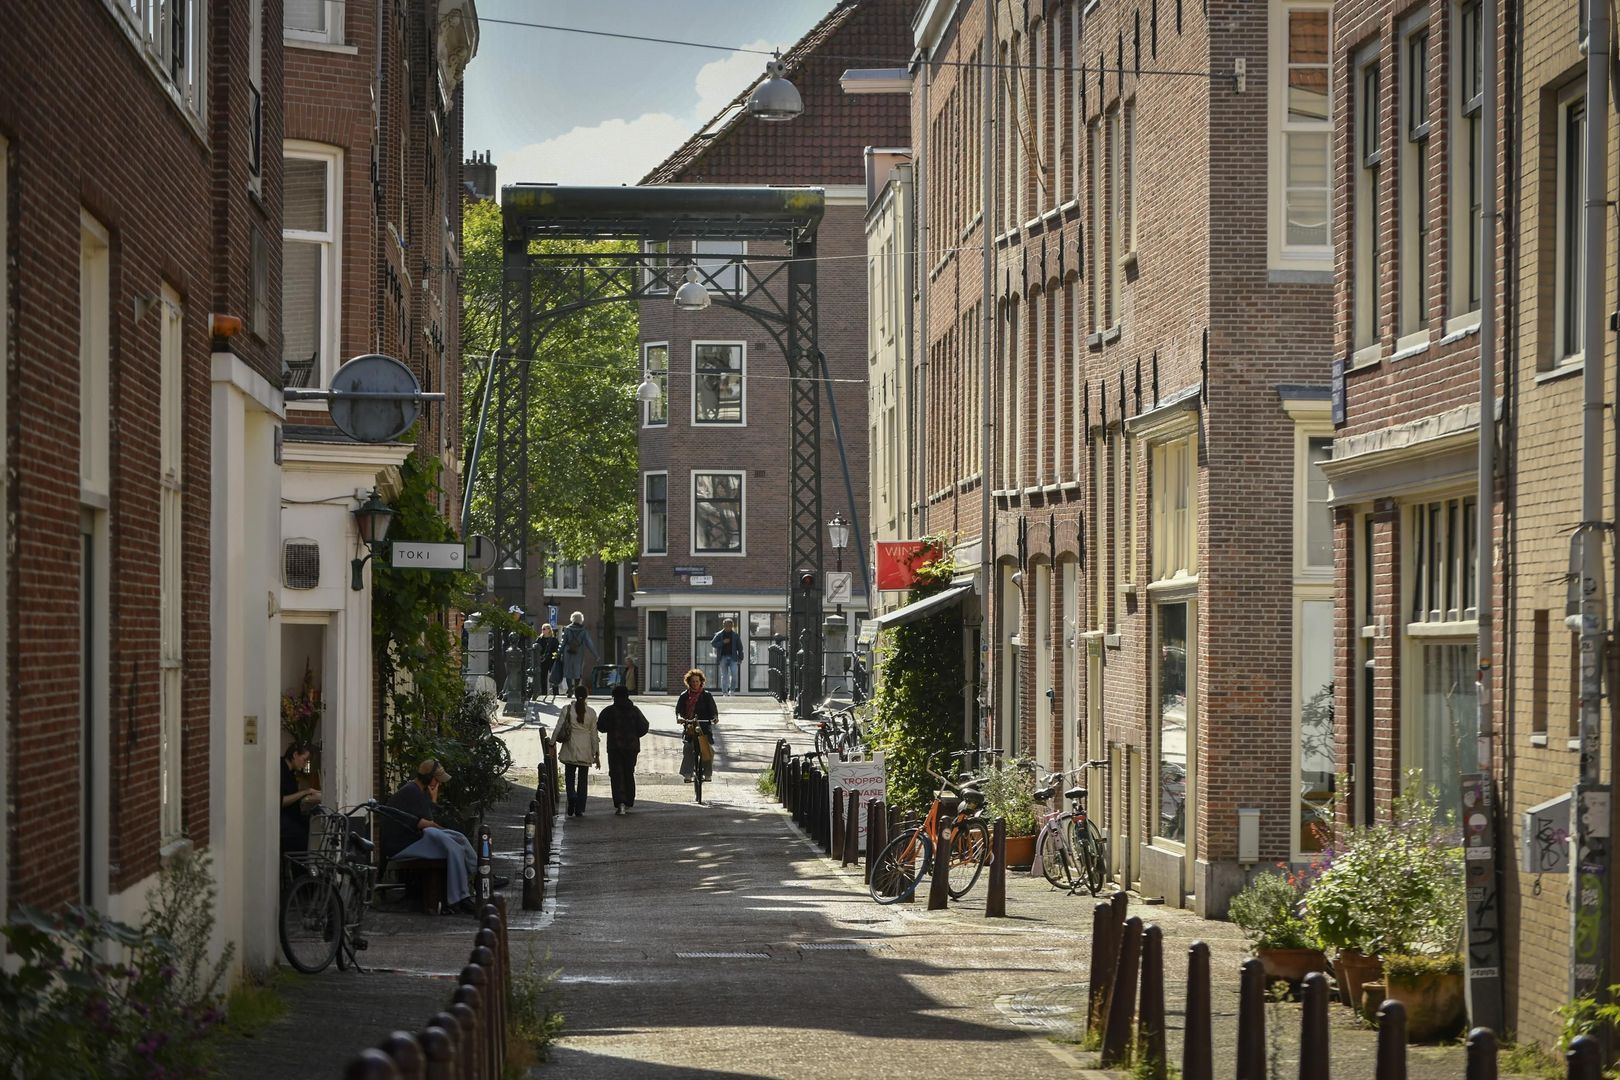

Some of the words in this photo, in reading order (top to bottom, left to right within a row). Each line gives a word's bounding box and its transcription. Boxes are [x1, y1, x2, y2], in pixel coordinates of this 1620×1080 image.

[399, 550, 430, 560] TOKI
[550, 607, 556, 619] P
[842, 777, 883, 785] TROPPO
